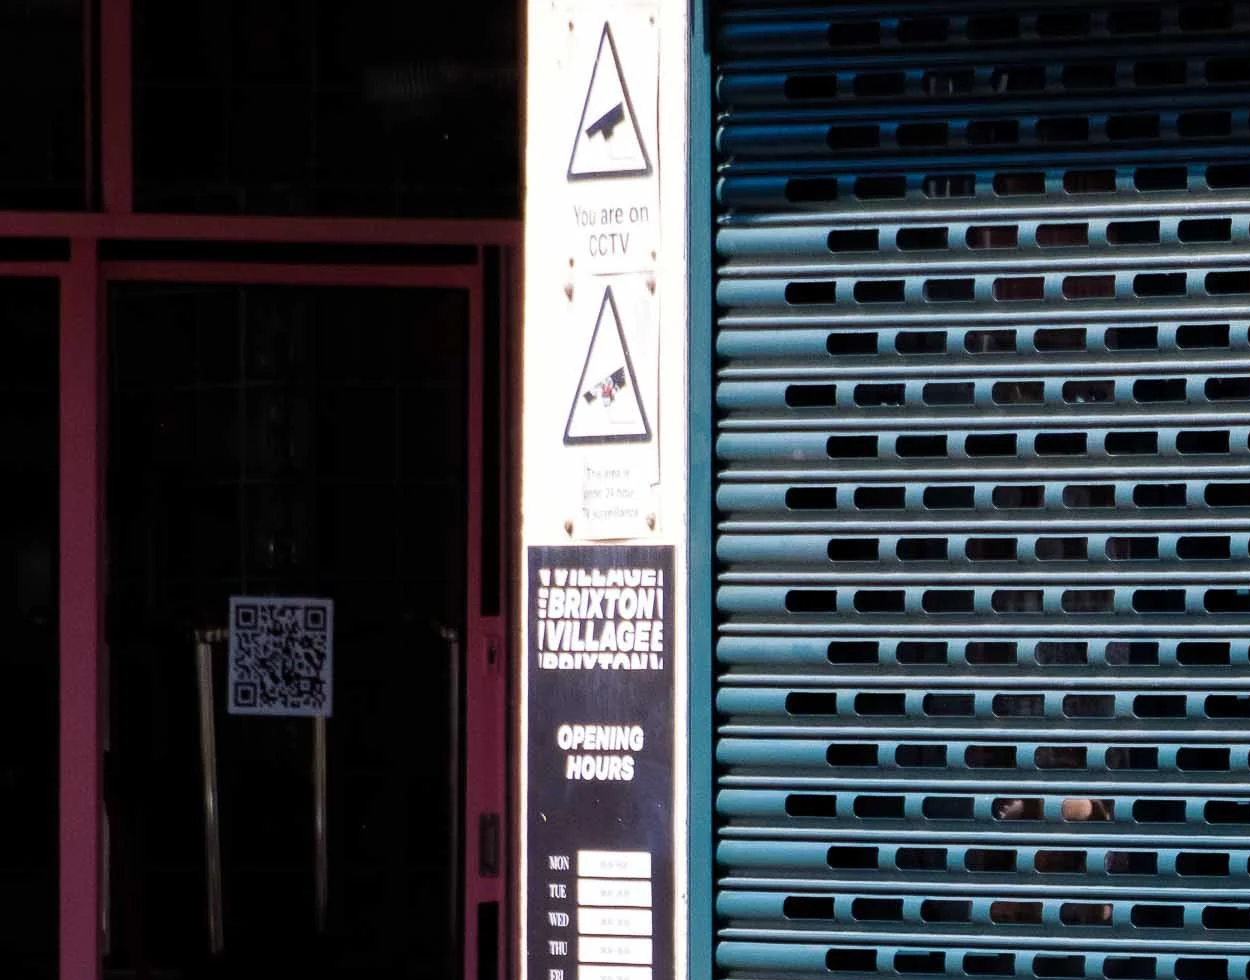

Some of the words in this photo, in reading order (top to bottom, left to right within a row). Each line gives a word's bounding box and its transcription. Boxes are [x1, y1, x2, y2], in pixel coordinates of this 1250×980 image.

[574, 205, 596, 227] You
[600, 206, 624, 225] are
[629, 205, 650, 224] on
[589, 232, 630, 256] CCTV
[548, 588, 655, 620] BRIXTON
[547, 620, 651, 652] VILLAGE
[557, 724, 645, 751] OPENING
[566, 754, 636, 781] HOURS
[549, 855, 570, 871] MON
[549, 883, 567, 899] TUE
[548, 912, 570, 928] WED
[548, 940, 568, 956] THU
